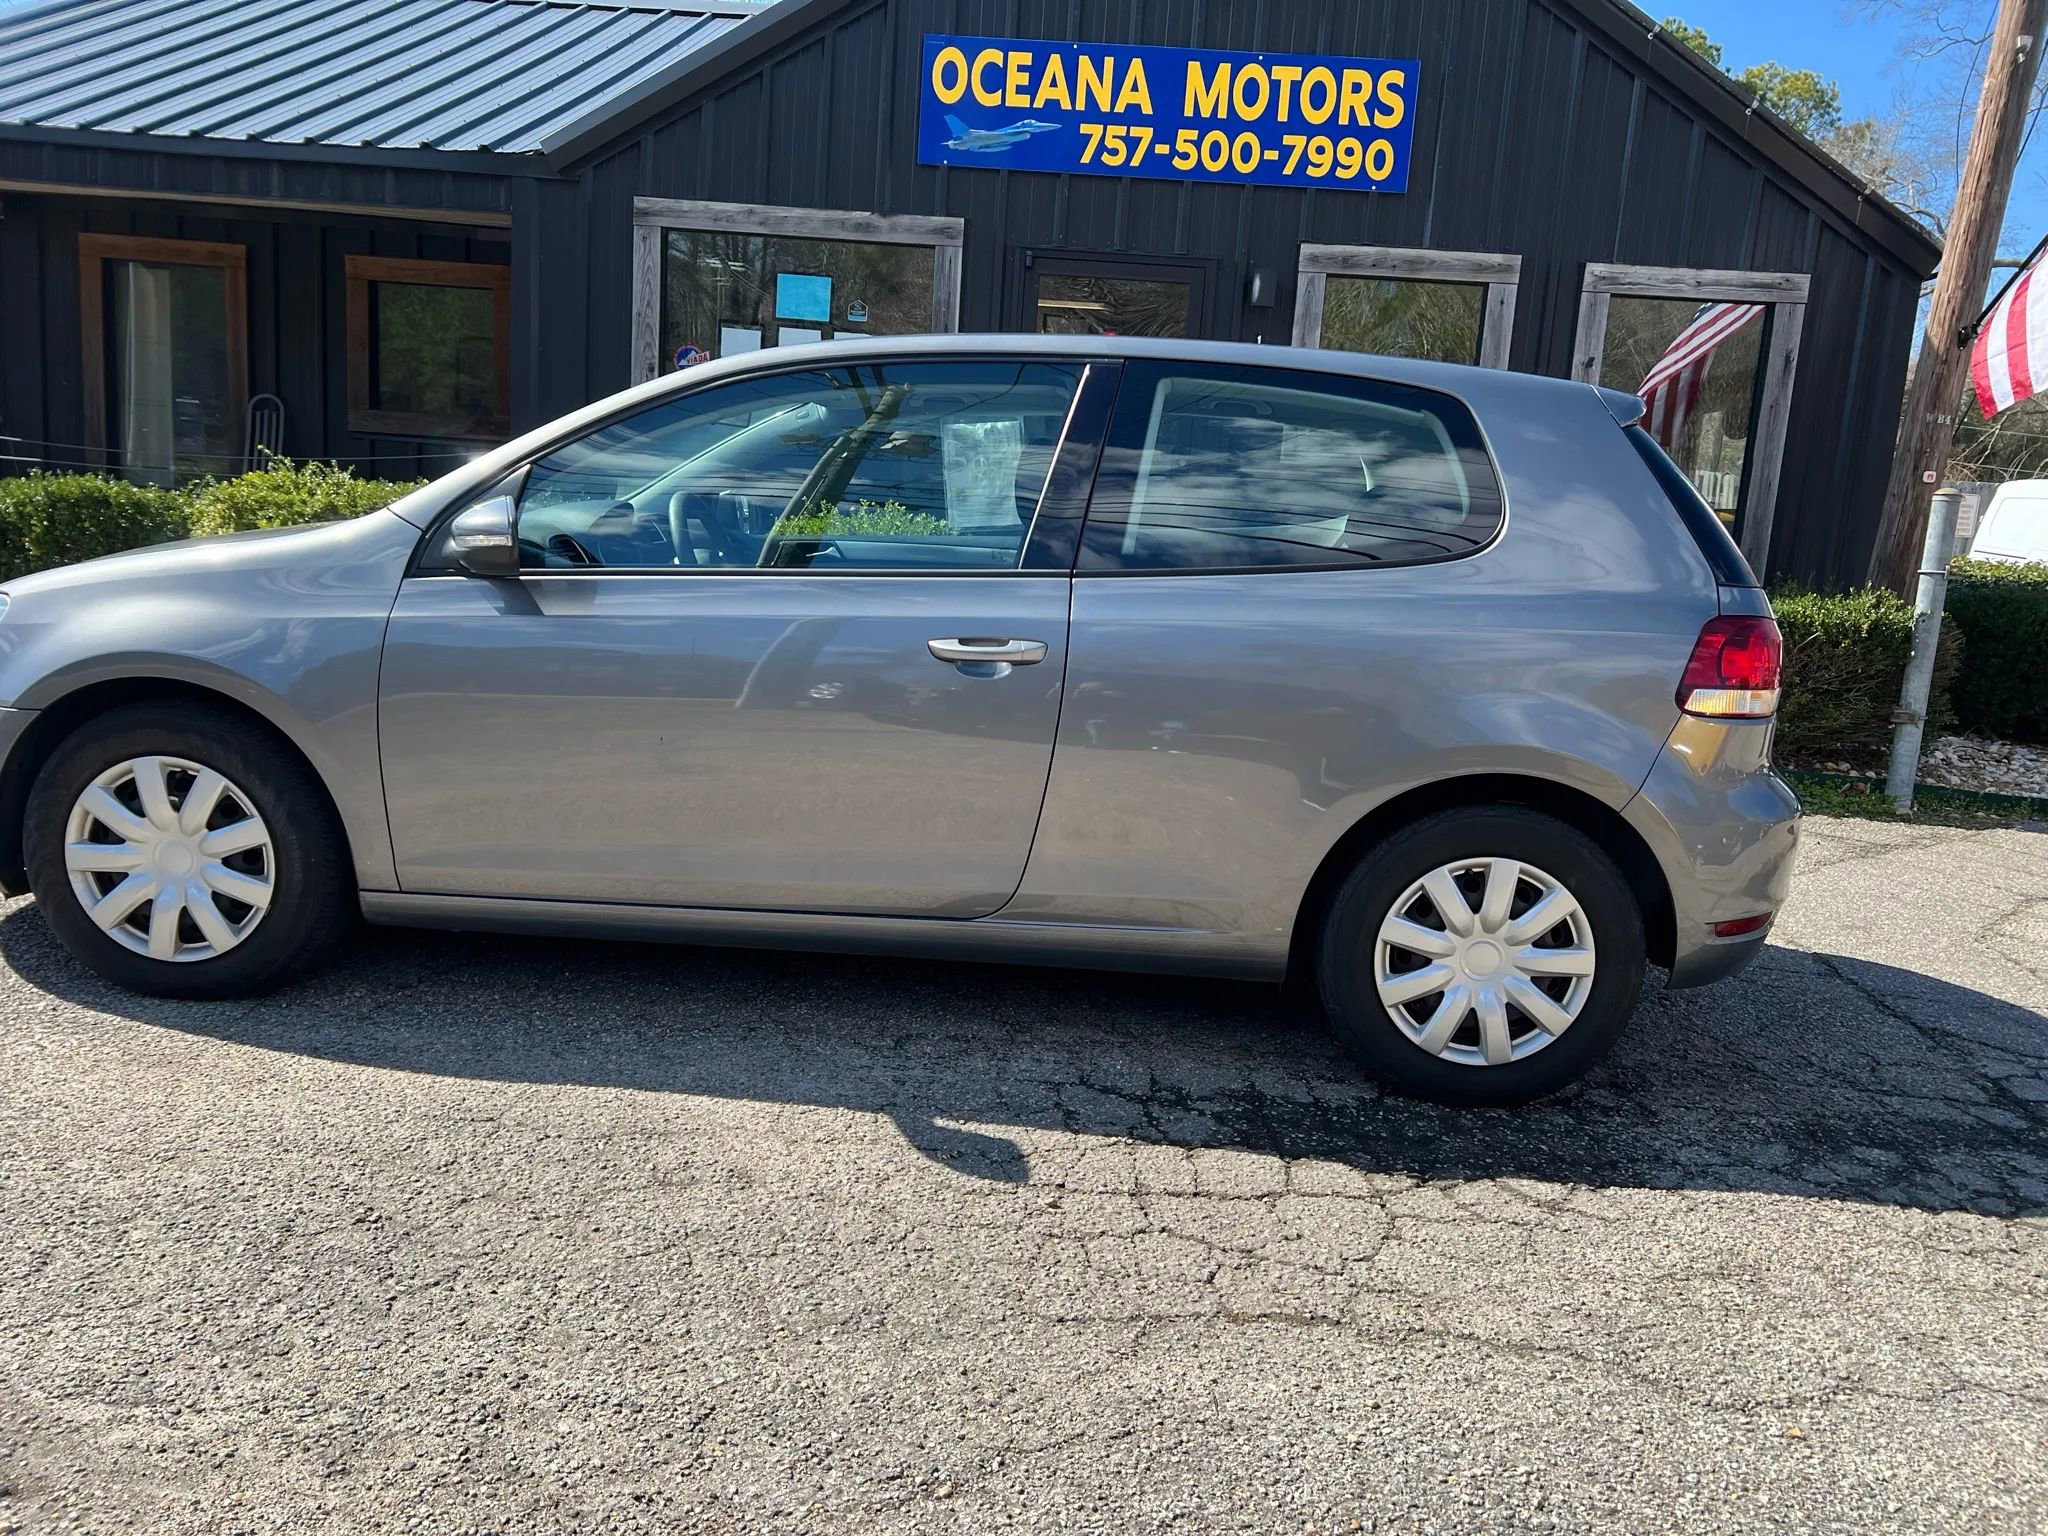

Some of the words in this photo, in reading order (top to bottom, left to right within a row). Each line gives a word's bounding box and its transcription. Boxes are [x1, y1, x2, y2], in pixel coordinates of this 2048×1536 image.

[931, 46, 1153, 115] OCEANA
[1183, 60, 1405, 129] MOTORS
[1079, 123, 1395, 181] 757-500-7990
[686, 353, 709, 364] VIADA
